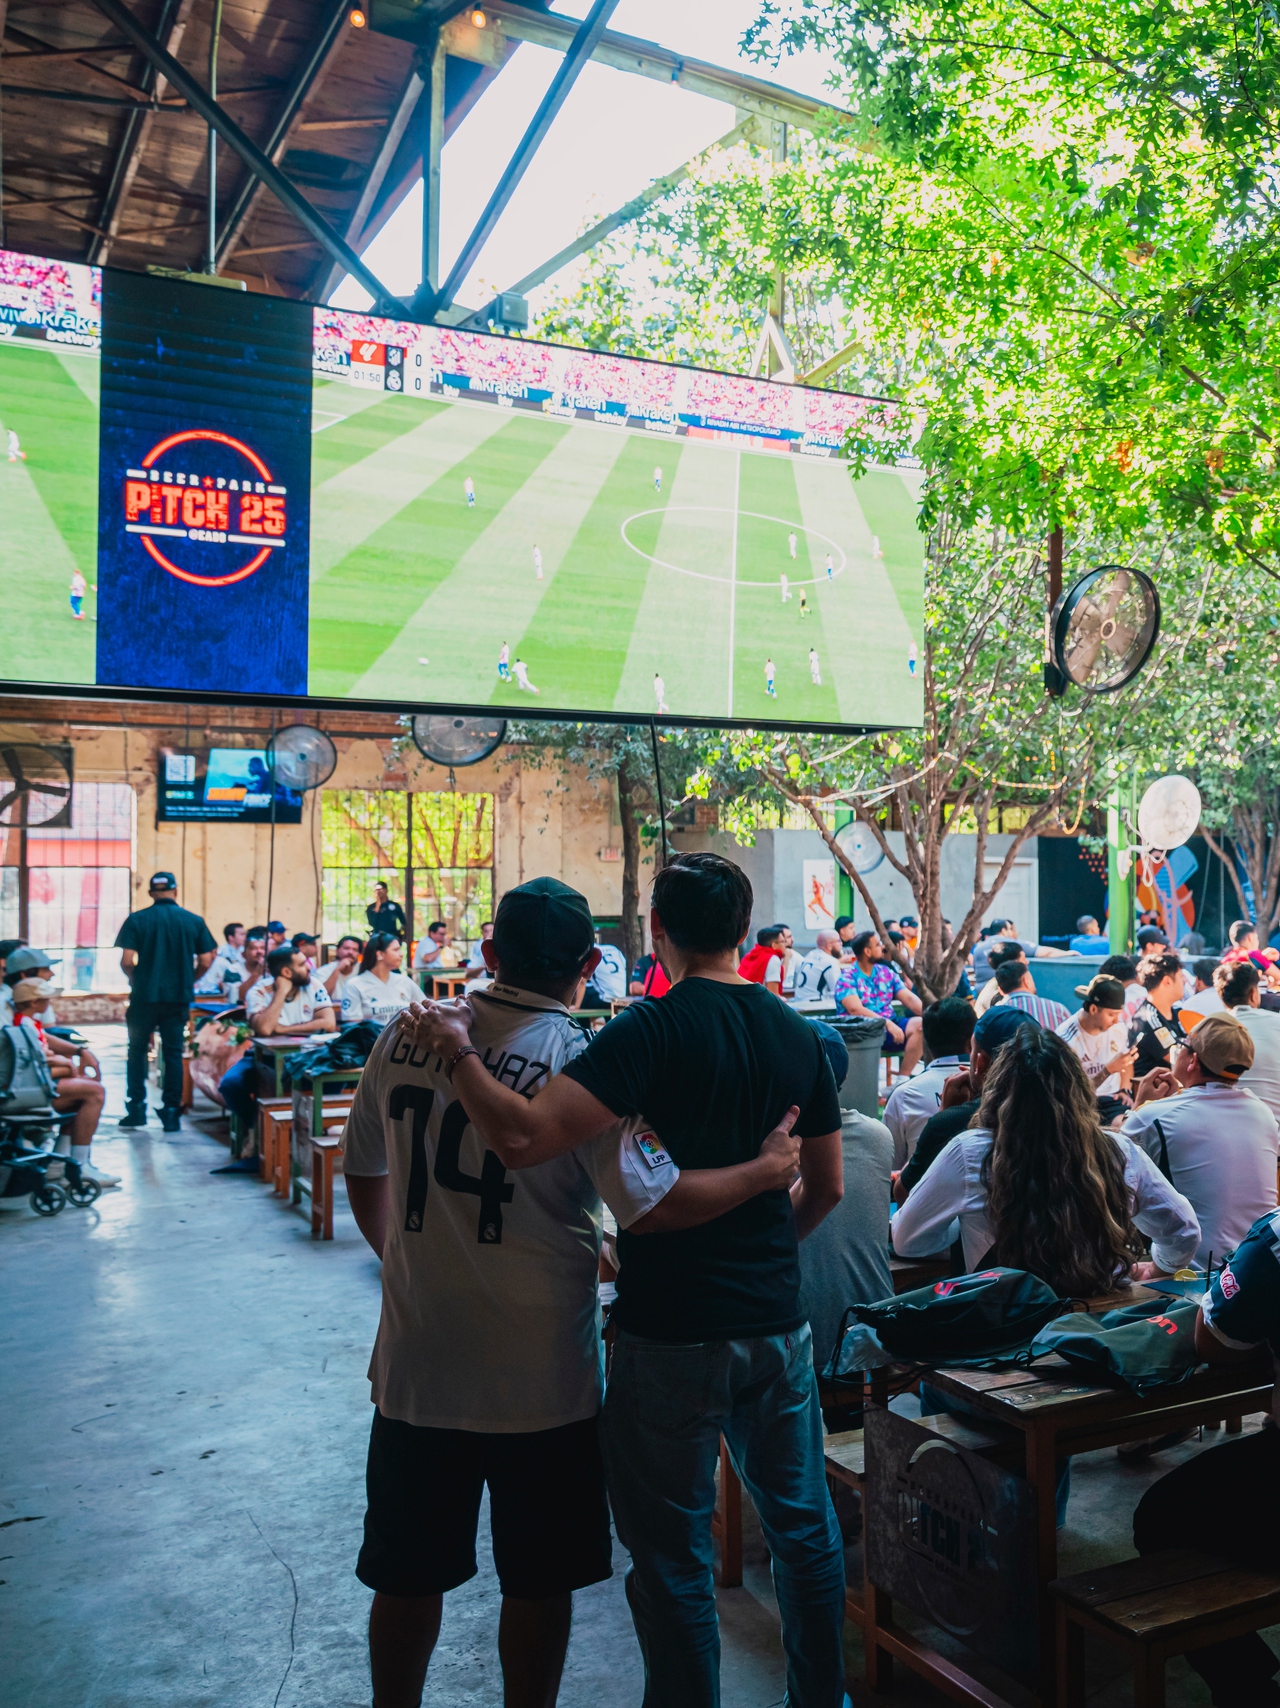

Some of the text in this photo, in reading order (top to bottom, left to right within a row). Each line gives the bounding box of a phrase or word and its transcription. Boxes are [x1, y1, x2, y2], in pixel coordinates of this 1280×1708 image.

[42, 310, 101, 334] krake
[46, 327, 101, 348] betway
[315, 348, 347, 365] ken
[415, 353, 422, 367] 0
[313, 360, 349, 376] betwa
[354, 370, 381, 383] 01:50
[414, 377, 422, 391] 0
[482, 379, 528, 399] kraken
[150, 469, 266, 494] BEER PARK
[125, 480, 287, 536] PITCH 25
[603, 953, 619, 974] 5
[388, 1083, 516, 1244] 14
